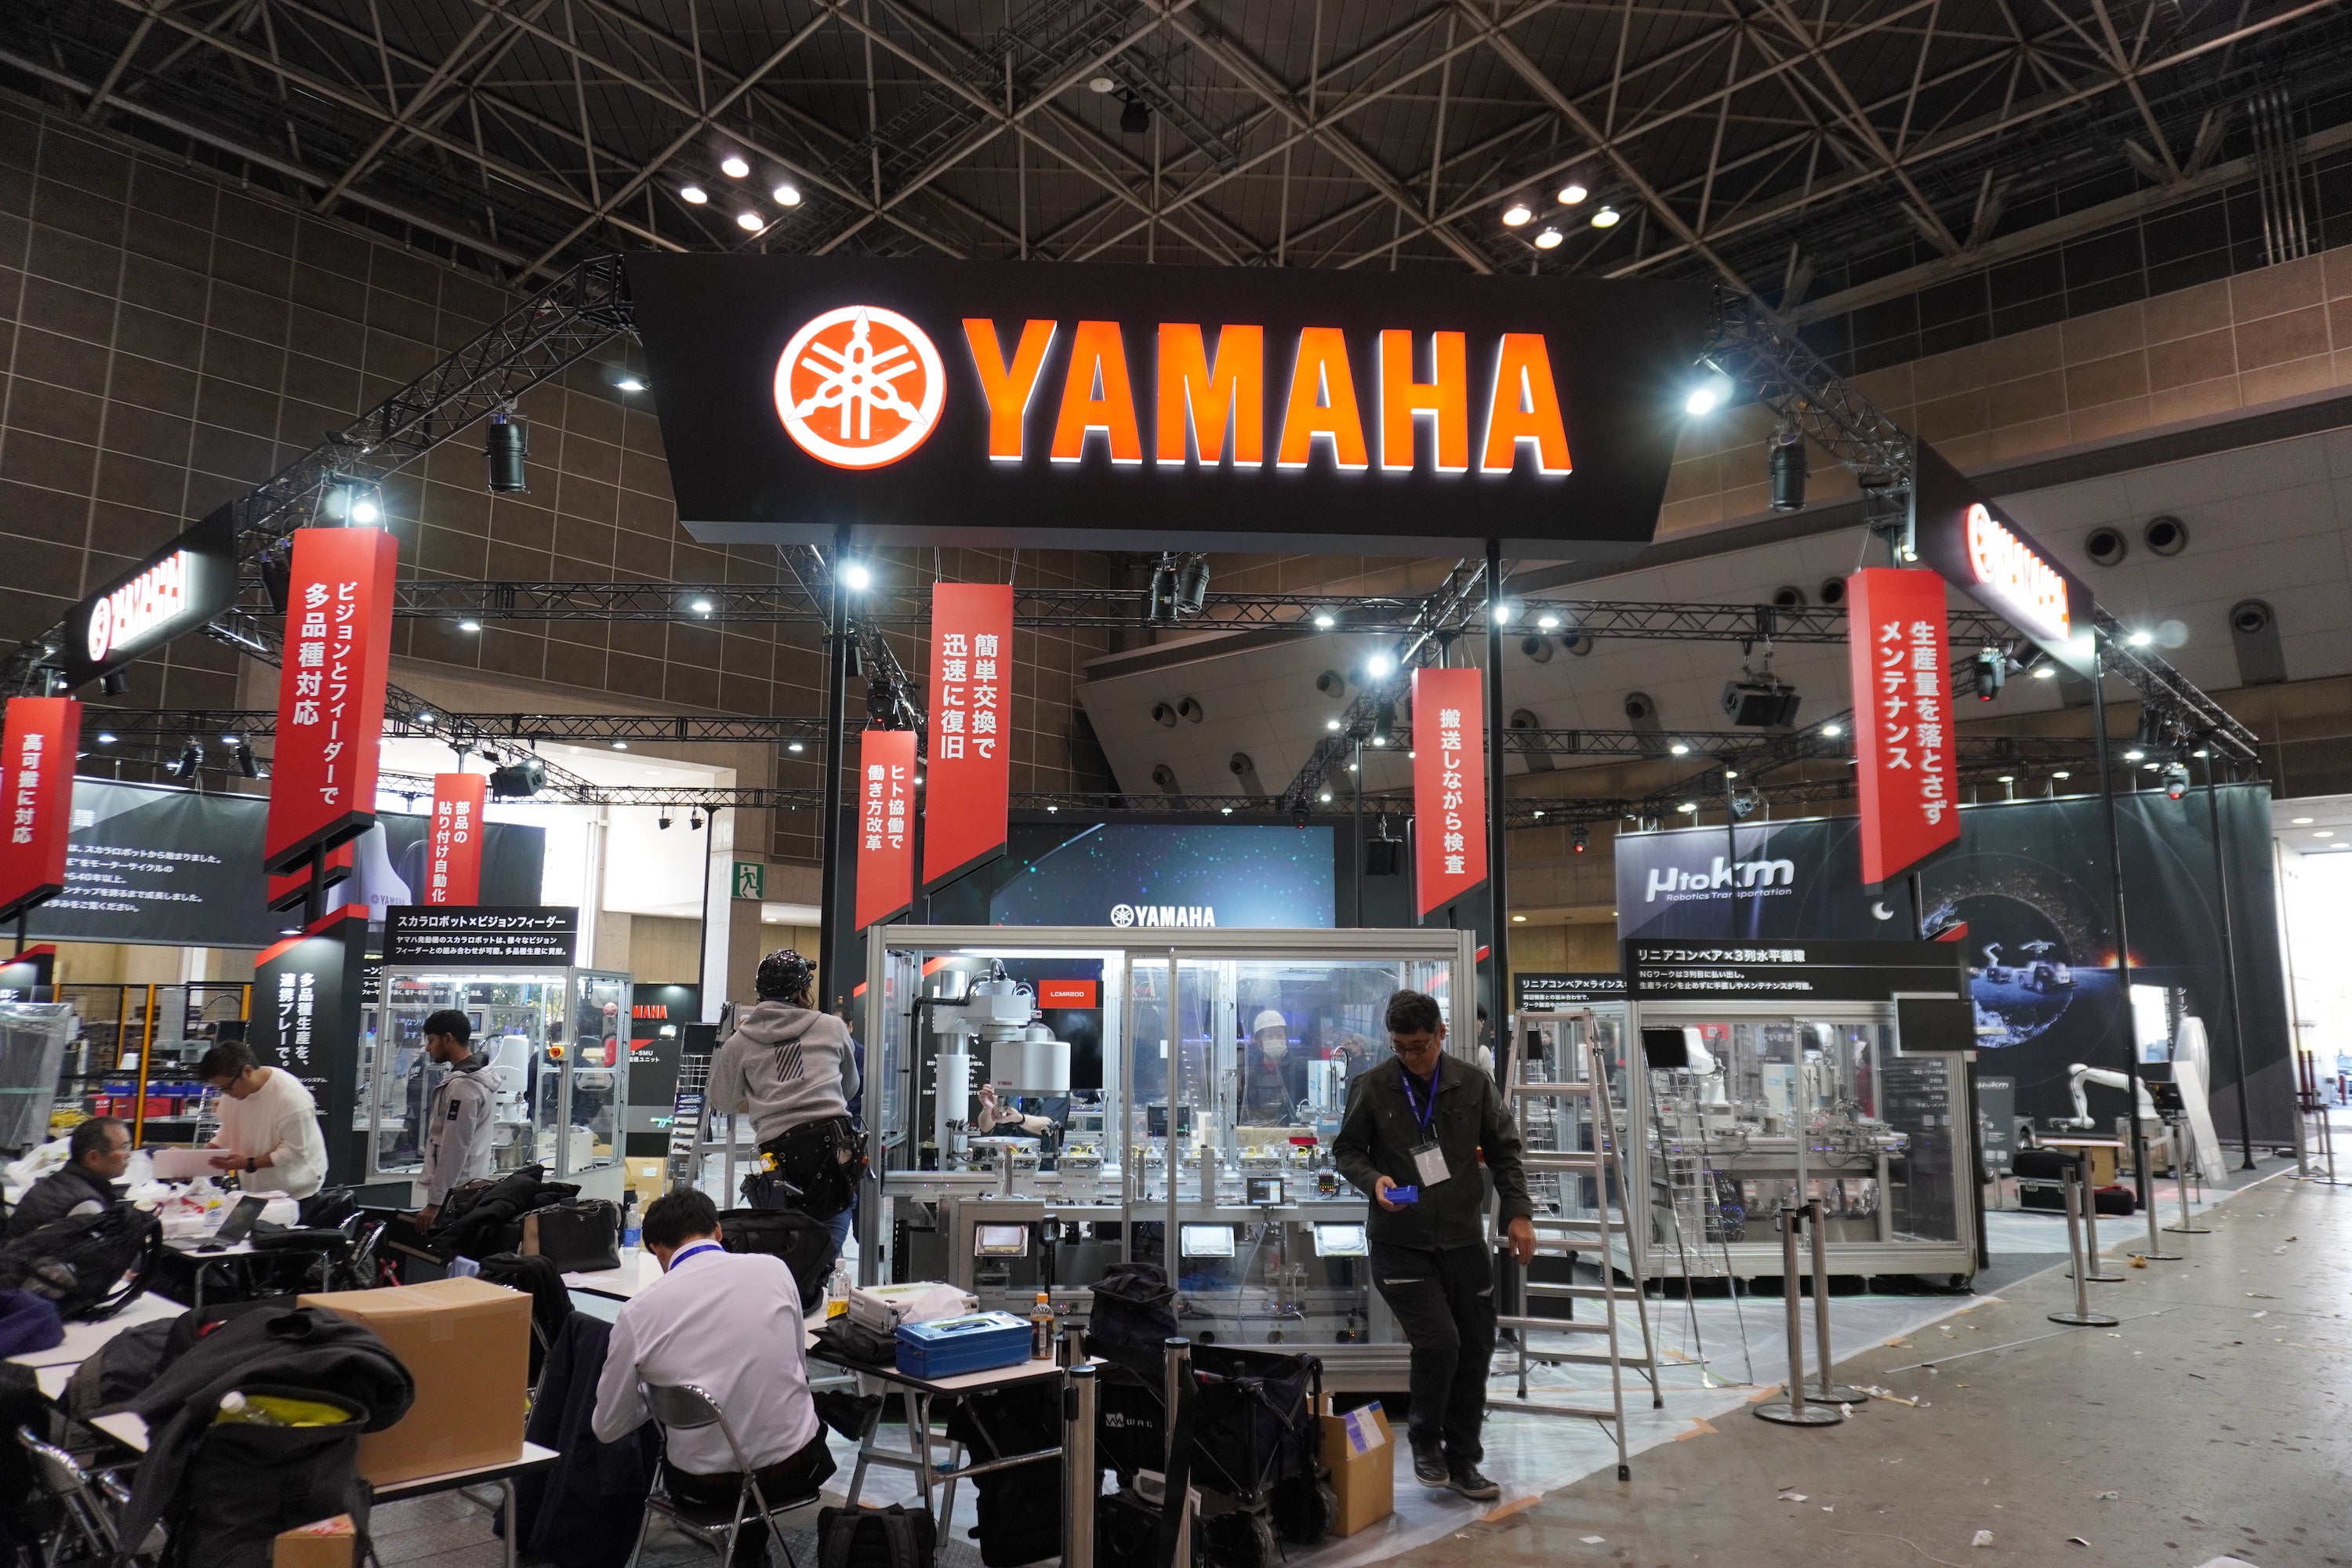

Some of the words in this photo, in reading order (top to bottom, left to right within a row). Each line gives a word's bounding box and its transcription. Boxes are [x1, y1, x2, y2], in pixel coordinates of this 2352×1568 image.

[961, 318, 1573, 475] YAMAHA
[292, 583, 331, 726] 多品種対応
[318, 582, 358, 806] ビジョンとフィーダーで
[940, 633, 968, 760] 迅速に復旧
[971, 633, 999, 760] 簡単交換で
[1880, 620, 1913, 771] メンテナンス
[1910, 620, 1947, 826] 生産量を落とさず
[12, 733, 45, 844] 高可搬に対応
[453, 800, 471, 844] 部品の
[865, 764, 885, 851] 働き方改革
[887, 764, 906, 850] ヒト協働で
[1439, 708, 1466, 875] 搬送しながら検査
[431, 800, 453, 903] 貼り付け自動化
[1667, 892, 1709, 901] Robotics
[396, 935, 557, 945] ヤマハ発動機のスカラロボットは、様々なビジョン
[397, 915, 566, 928] スカラロボット×ビジョンフィーダー
[1135, 906, 1215, 927] YAMAHA
[1639, 949, 1806, 963] リニアコンベア×3列水平循環
[275, 972, 297, 1067] 連携プレーで。
[295, 972, 315, 1065] 多品種生産を、
[1639, 970, 1745, 978] NGワークは3列目に払い出し。
[1639, 981, 1814, 990] 生産ラインを止めずに手直しやメンテナンスが可能。
